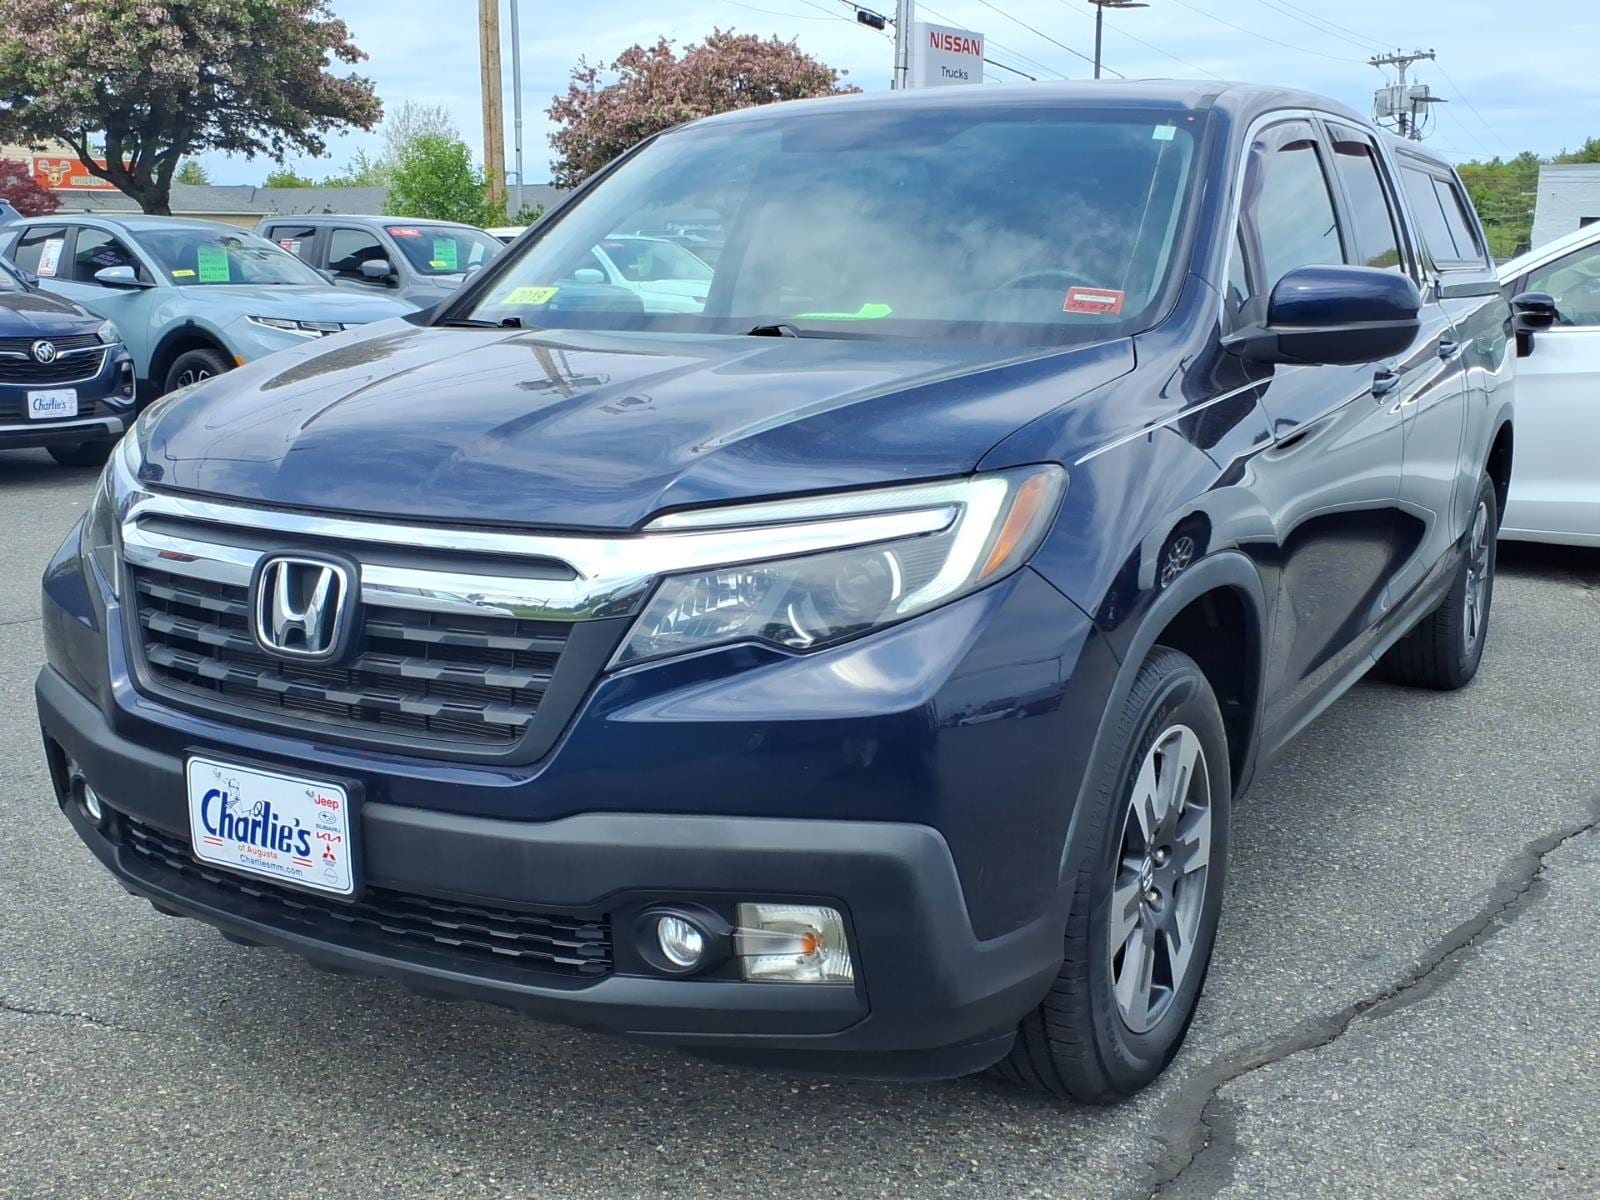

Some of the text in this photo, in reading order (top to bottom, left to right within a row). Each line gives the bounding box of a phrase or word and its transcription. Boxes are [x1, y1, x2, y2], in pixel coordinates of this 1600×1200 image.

[930, 31, 980, 56] NISSAN
[941, 65, 968, 80] Trucks
[33, 397, 67, 411] Charlie's
[314, 794, 339, 811] Jeep
[201, 788, 311, 857] Charlie's
[238, 843, 278, 860] of Augusta
[239, 854, 303, 877] Charliesmm.com
